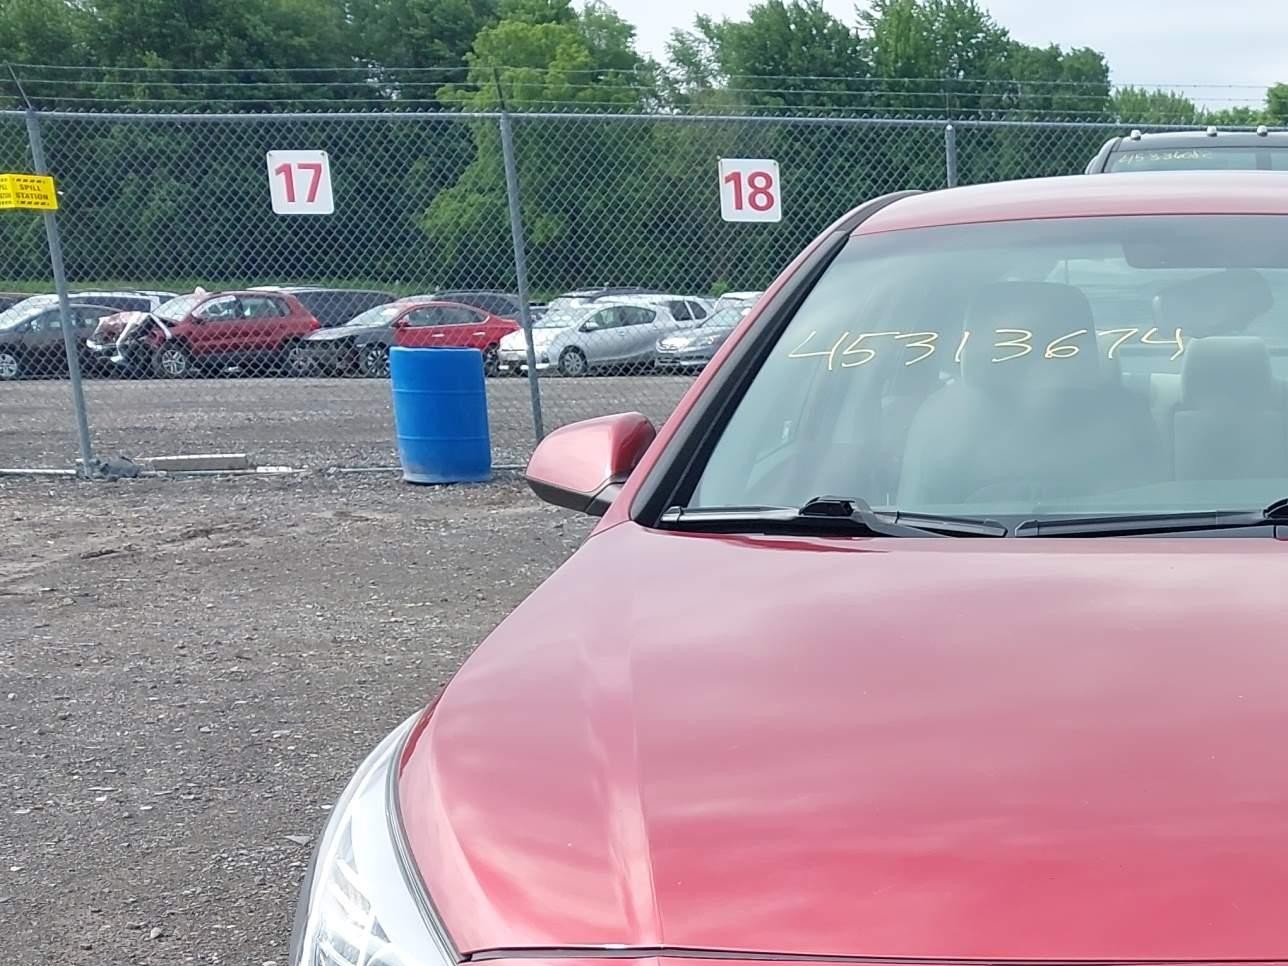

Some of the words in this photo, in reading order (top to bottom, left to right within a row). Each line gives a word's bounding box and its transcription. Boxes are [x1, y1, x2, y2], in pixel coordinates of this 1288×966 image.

[275, 163, 322, 203] 17
[724, 171, 775, 211] 18
[788, 327, 1185, 371] 45313674
